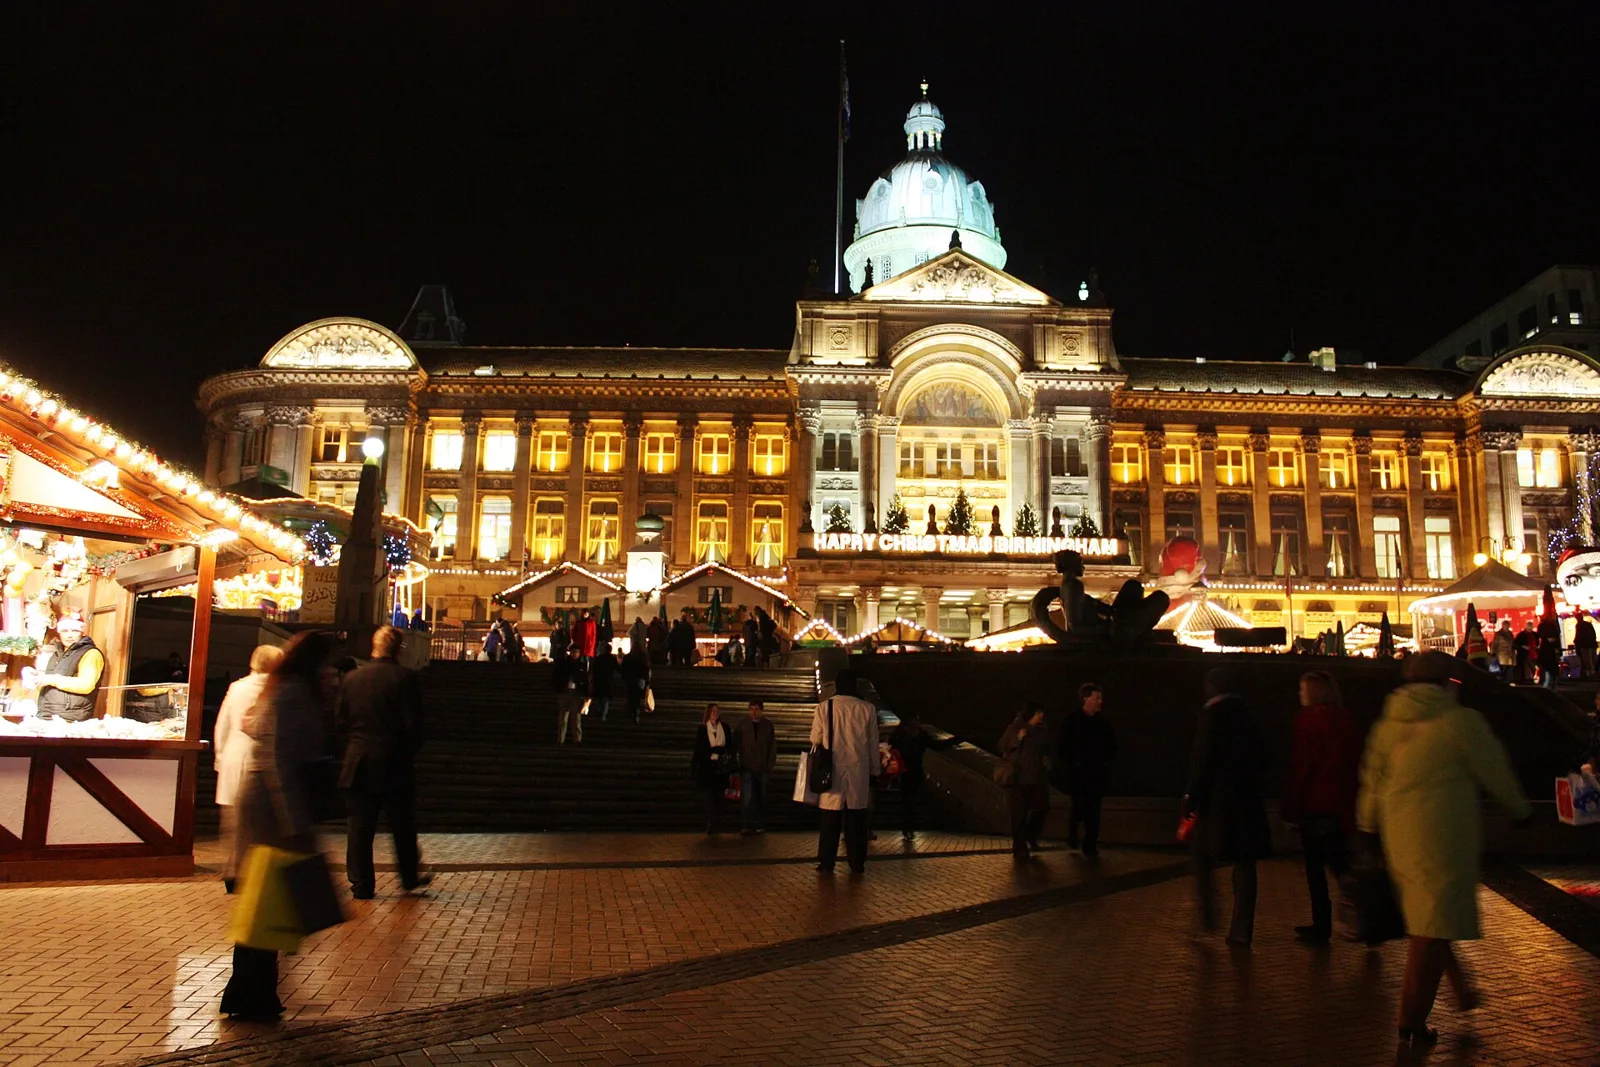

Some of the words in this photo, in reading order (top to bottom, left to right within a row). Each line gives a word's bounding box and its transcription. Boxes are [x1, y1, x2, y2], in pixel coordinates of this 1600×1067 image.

[813, 533, 876, 551] HAPPY
[879, 534, 992, 553] CHRISTMAS
[994, 536, 1118, 555] BIRMINGHAM
